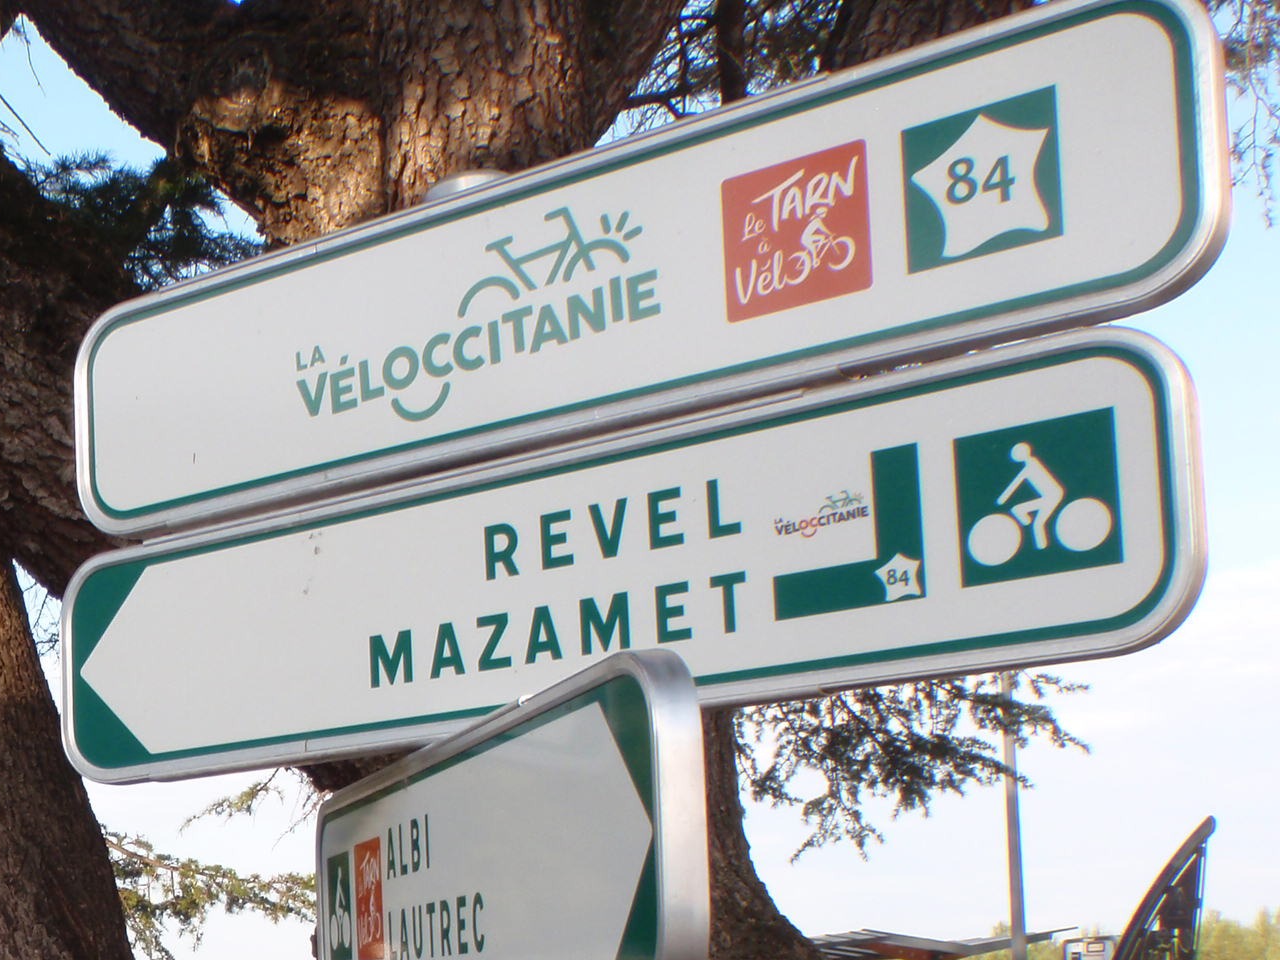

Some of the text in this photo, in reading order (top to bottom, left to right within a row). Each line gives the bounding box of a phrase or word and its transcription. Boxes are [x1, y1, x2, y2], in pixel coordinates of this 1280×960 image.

[751, 155, 859, 232] TARN
[944, 154, 1016, 206] 84
[295, 345, 326, 372] LA
[296, 268, 662, 418] VÉLOCCITANIE
[484, 478, 742, 581] REVEL
[774, 517, 784, 525] LA
[775, 505, 870, 536] VÉLOCCITANIE
[886, 568, 910, 587] 84
[369, 570, 746, 689] MAZAMET
[386, 813, 431, 880] ALBI
